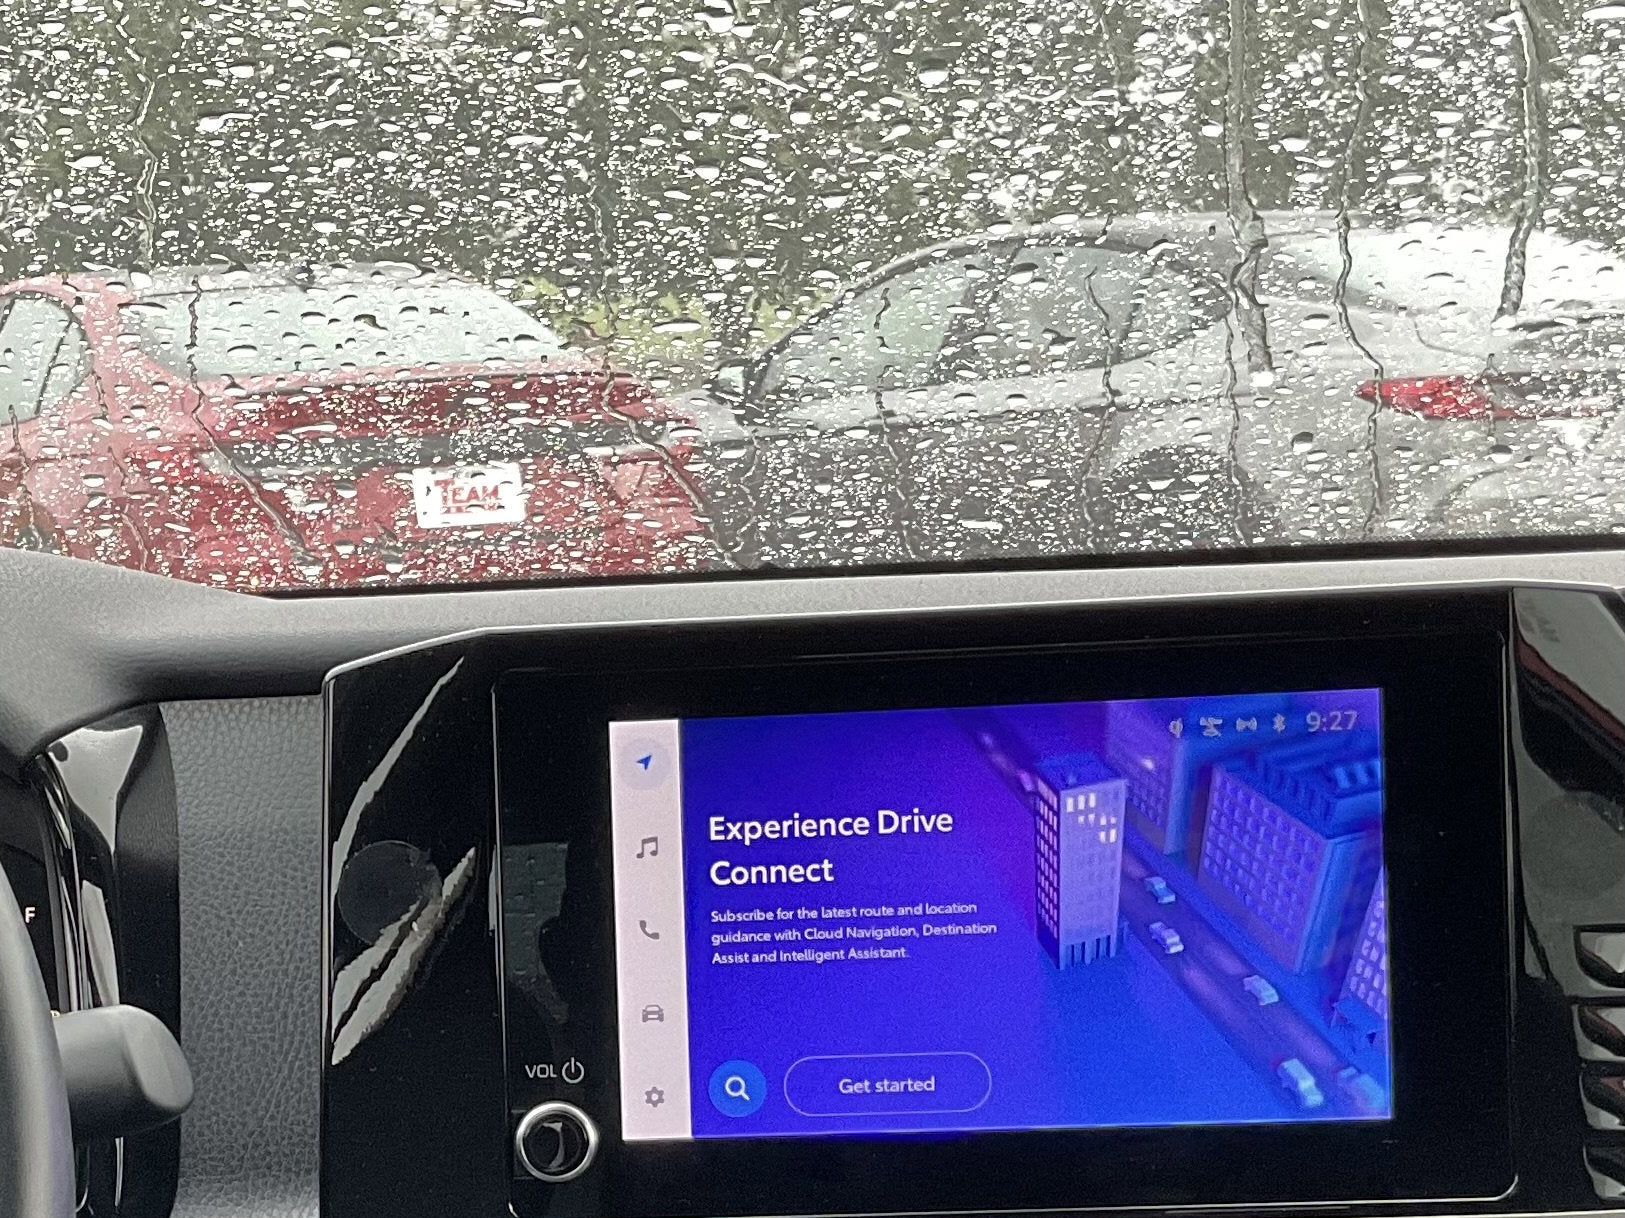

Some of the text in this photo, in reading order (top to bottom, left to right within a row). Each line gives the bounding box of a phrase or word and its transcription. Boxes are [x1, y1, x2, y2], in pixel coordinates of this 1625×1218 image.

[434, 478, 499, 505] TEAM
[1306, 710, 1358, 732] 9:27
[709, 807, 953, 846] Experience Drive
[710, 858, 835, 885] Connect
[25, 906, 36, 923] F
[711, 902, 978, 922] Subscribe for the latest route and location
[711, 922, 997, 946] guidance with Cloud Navigation, Destination
[712, 951, 749, 964] Assist
[752, 949, 776, 963] and
[780, 947, 845, 964] Intelligent
[525, 1063, 558, 1078] VOL
[839, 1075, 935, 1094] Get started
